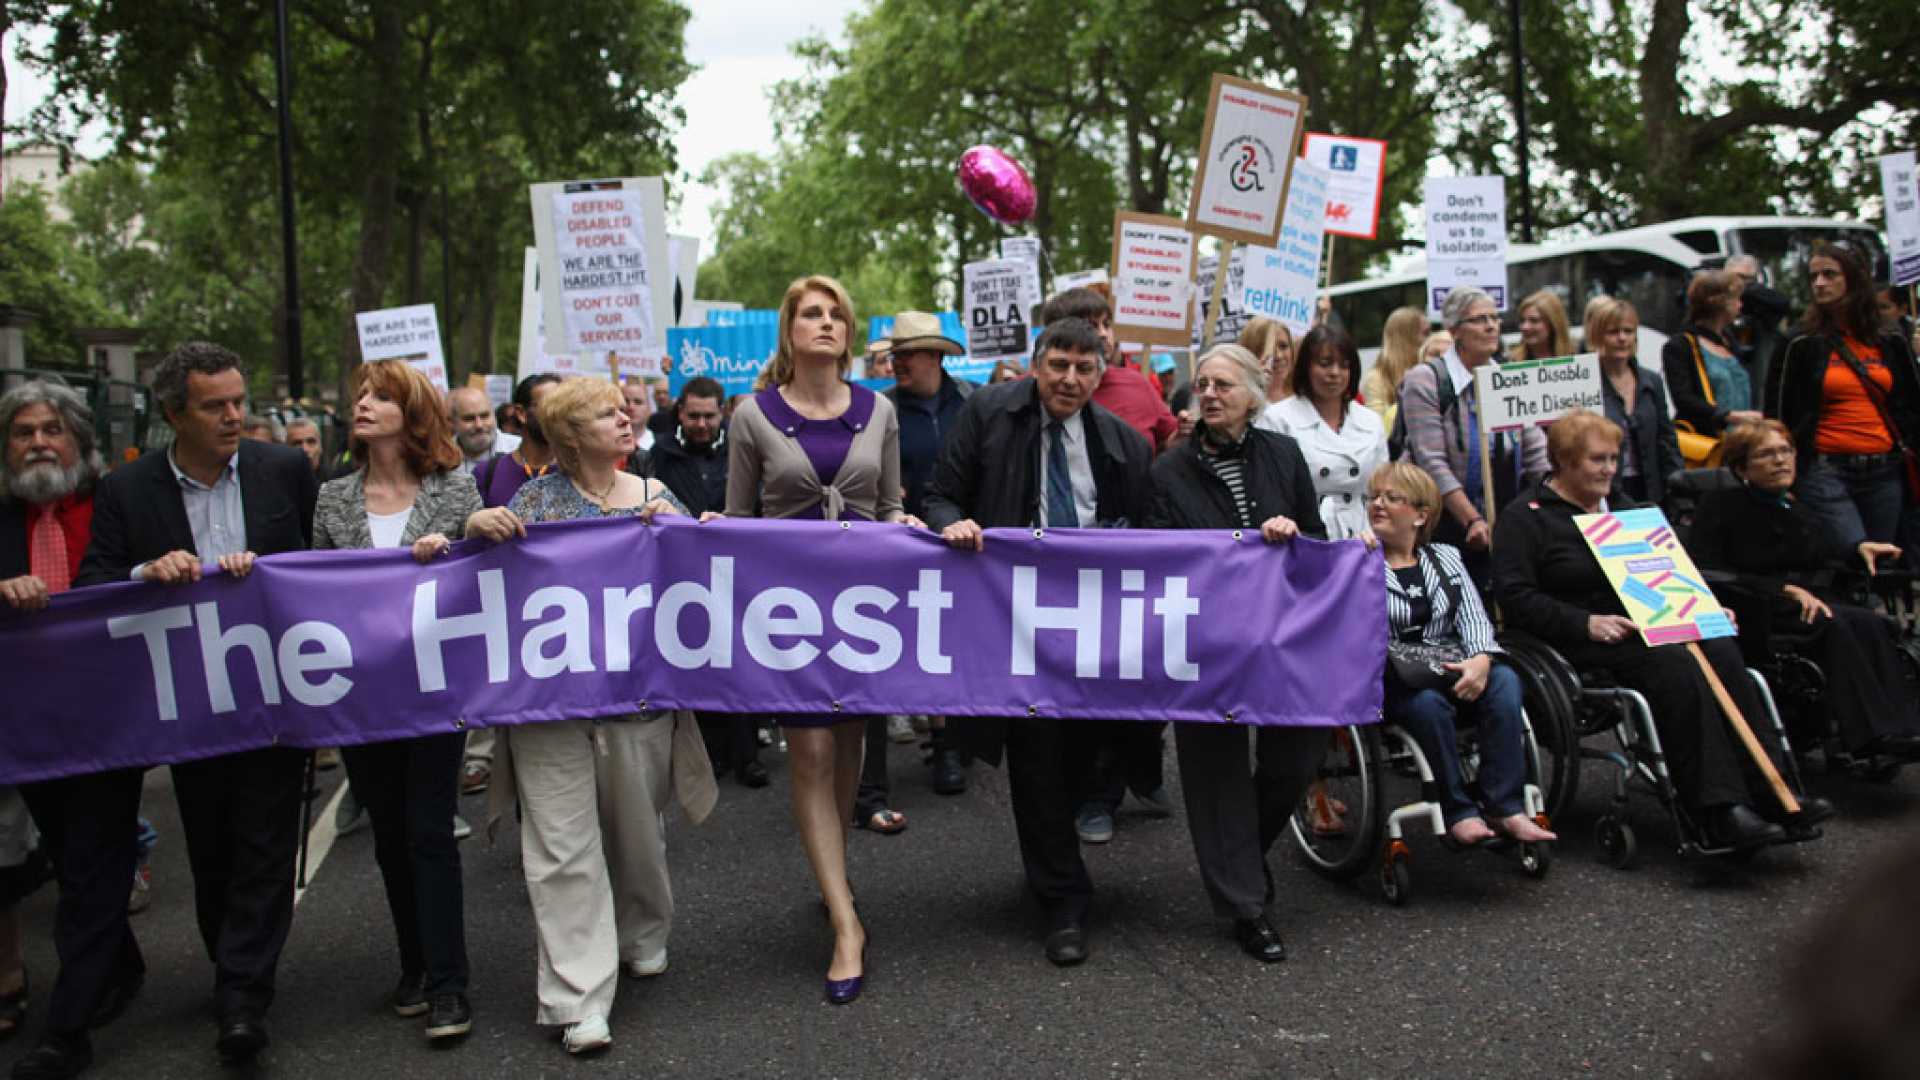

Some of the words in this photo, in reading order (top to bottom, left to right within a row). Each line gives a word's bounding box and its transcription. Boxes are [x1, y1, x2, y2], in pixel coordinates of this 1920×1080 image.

[571, 200, 625, 214] DEFEND
[1447, 194, 1483, 208] Don't
[567, 215, 632, 232] DISABLED
[1432, 210, 1498, 223] condemn
[1449, 227, 1466, 238] us
[1470, 225, 1485, 238] to
[575, 232, 626, 249] PEOPLE
[1436, 240, 1498, 254] isolation
[563, 256, 584, 272] WE
[588, 253, 614, 269] ARE
[617, 251, 642, 267] THE
[563, 270, 625, 289] HARDEST
[626, 268, 647, 285] HIT
[1134, 277, 1154, 287] OUT
[573, 296, 612, 310] DON'T
[615, 294, 640, 308] CUT
[1244, 286, 1309, 323] rethink
[594, 312, 622, 326] OUR
[973, 303, 1023, 328] DLA
[1120, 305, 1181, 320] EDUCATION
[365, 322, 381, 335] WE
[385, 319, 407, 332] ARE
[410, 316, 431, 328] THE
[364, 333, 416, 348] HARDEST
[579, 327, 642, 343] SERVICES
[1491, 370, 1528, 391] Dont
[1537, 363, 1591, 384] Disable
[1502, 395, 1537, 417] The
[107, 602, 353, 720] The
[412, 557, 953, 692] Hardest
[1011, 566, 1200, 681] Hit
